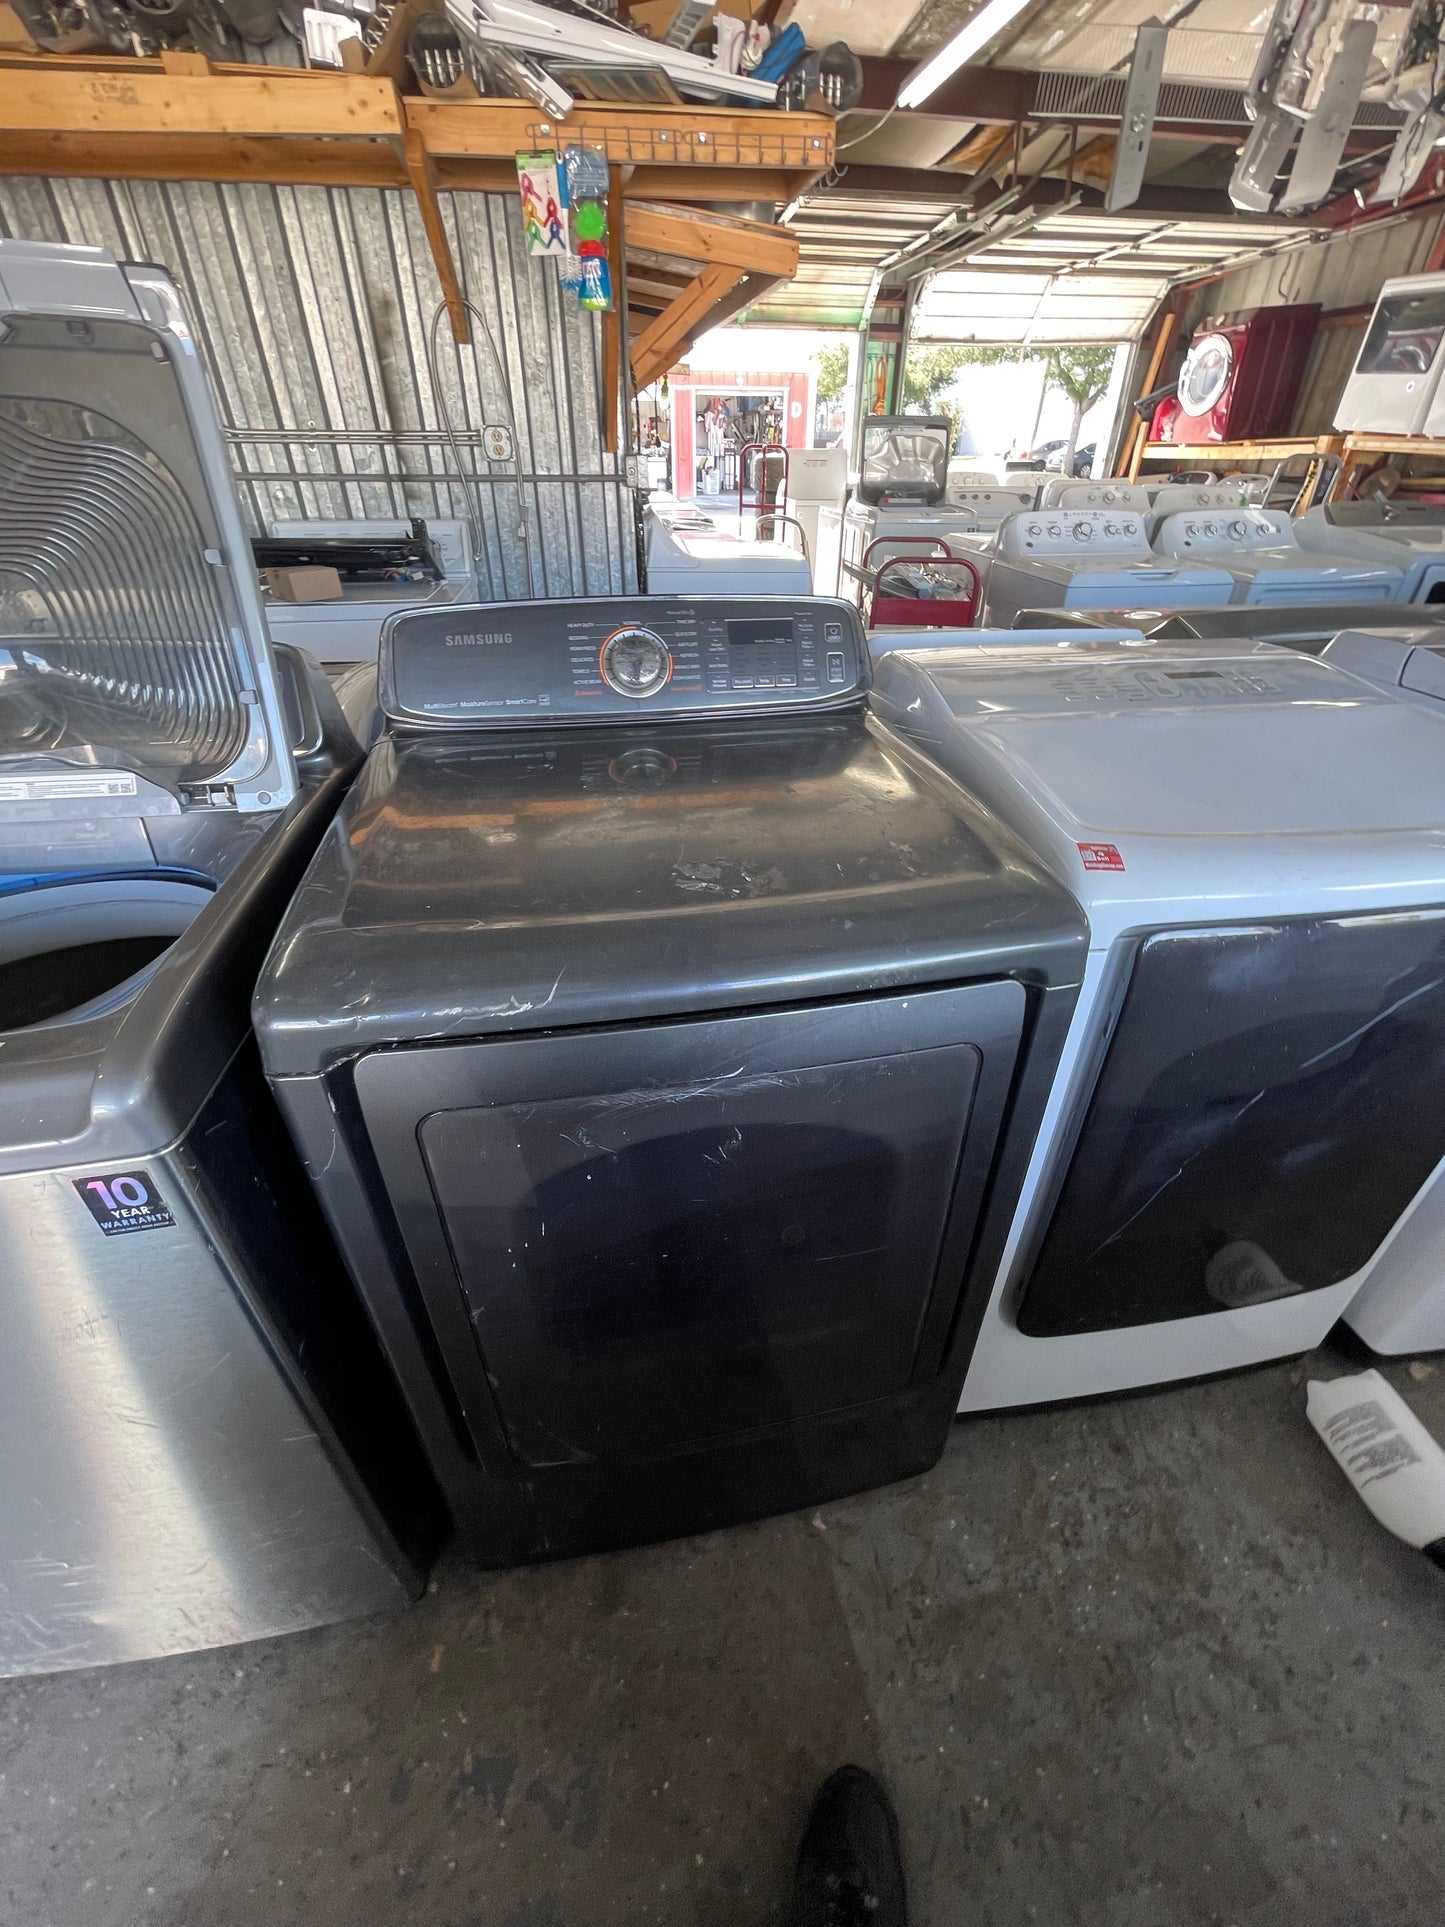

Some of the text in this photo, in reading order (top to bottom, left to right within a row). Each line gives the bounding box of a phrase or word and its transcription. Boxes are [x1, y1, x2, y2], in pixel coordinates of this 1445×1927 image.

[445, 633, 513, 646] SAMSUNG
[87, 1176, 148, 1210] 10
[110, 1206, 151, 1219] YEAR
[100, 1212, 170, 1229] WARRANTY
